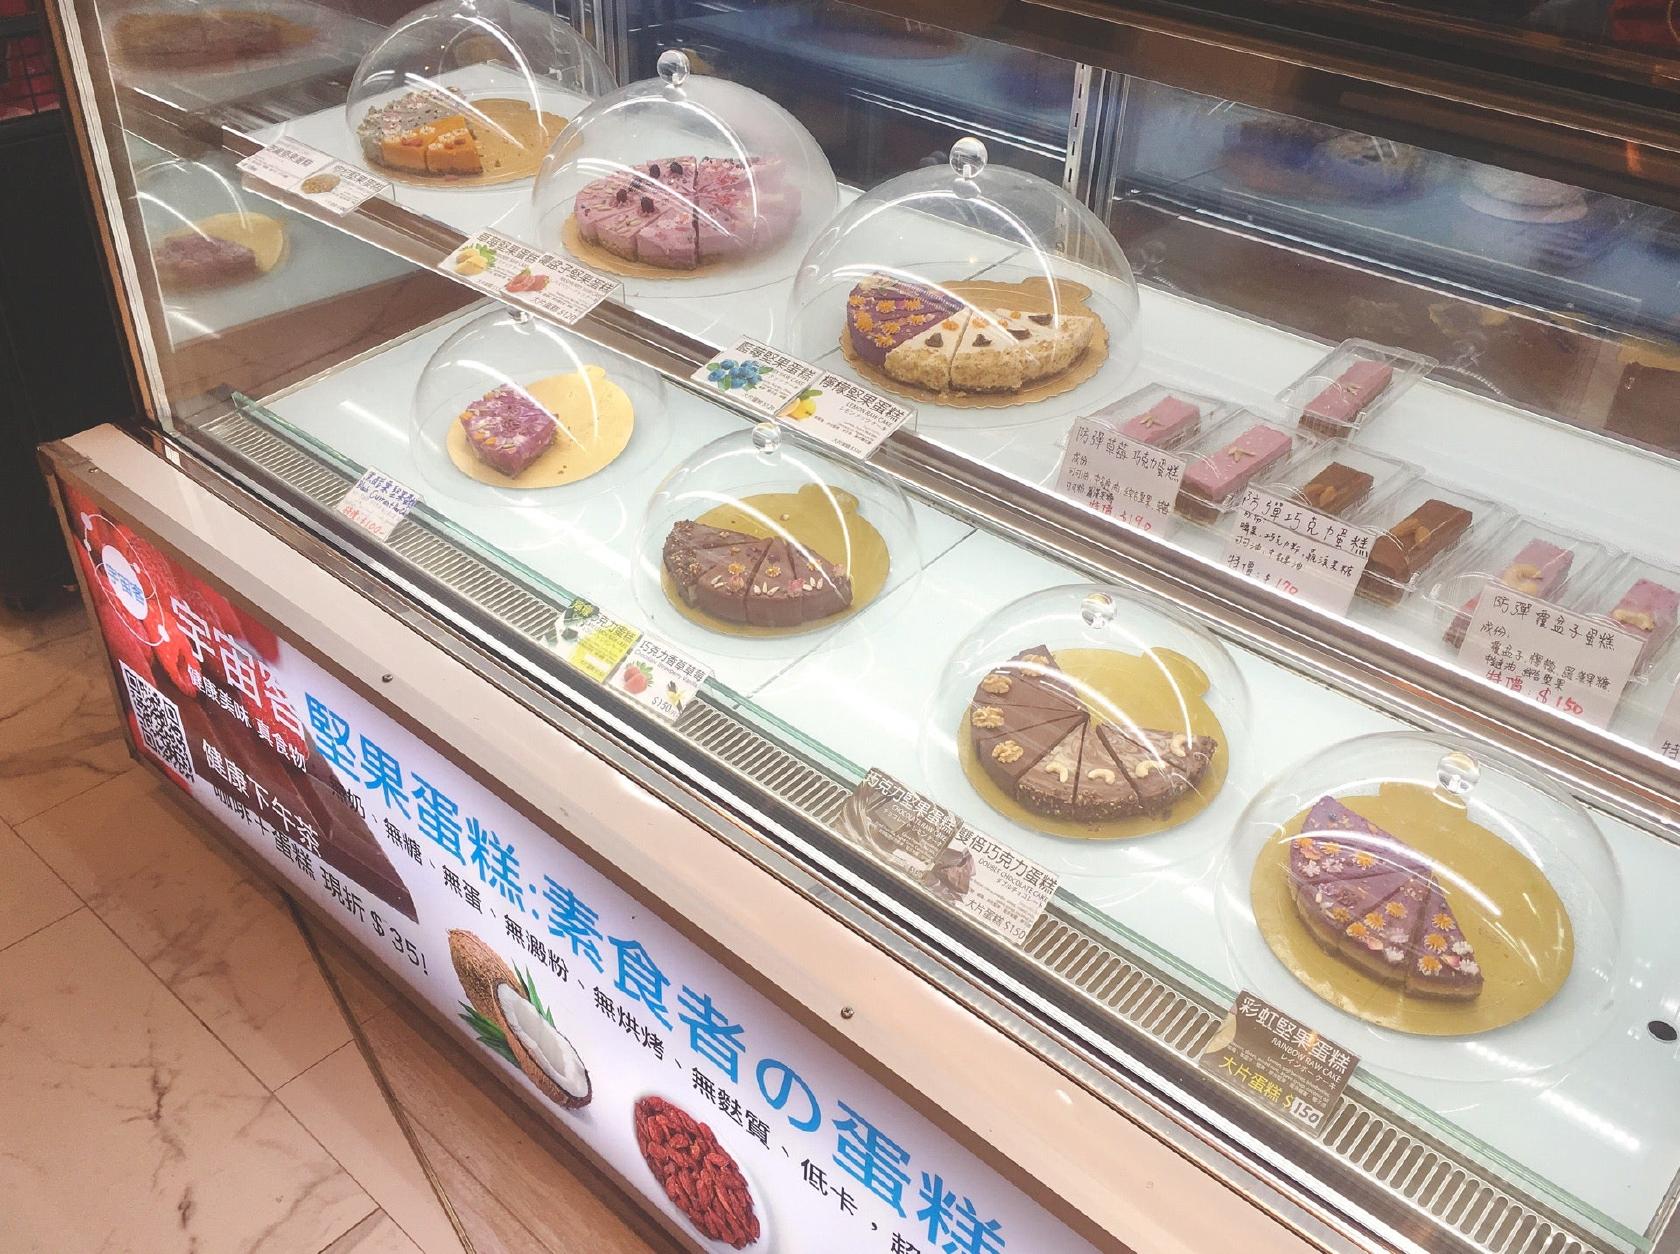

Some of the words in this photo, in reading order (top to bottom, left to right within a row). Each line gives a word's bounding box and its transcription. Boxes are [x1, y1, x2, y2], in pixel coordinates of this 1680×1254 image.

[819, 375, 905, 422] 檸檬堅果蛋糕
[1242, 491, 1369, 558] 防彈巧克力蛋糕
[1493, 596, 1615, 651] 防彈覆盆子蛋糕
[187, 663, 252, 729] 健康美味
[256, 717, 307, 774] 真食物
[202, 738, 321, 858] 健康下午茶
[866, 769, 955, 834] 巧克力堅果蛋糕
[955, 826, 1058, 896] 雙倍巧克力蛋糕
[978, 857, 1001, 876] DOUBLE
[999, 869, 1035, 897] CHOCOLATE
[1032, 886, 1049, 902] CAKE
[319, 865, 365, 922] 現折
[965, 898, 1004, 929] 大片蛋糕
[1002, 919, 1027, 941] $150
[1239, 998, 1350, 1074] 彩虹堅果蛋糕
[1271, 1036, 1306, 1061] RAINBOW
[1304, 1057, 1323, 1073] RAW
[1322, 1066, 1342, 1084] CAKE
[1219, 1055, 1283, 1103] 大片蛋糕
